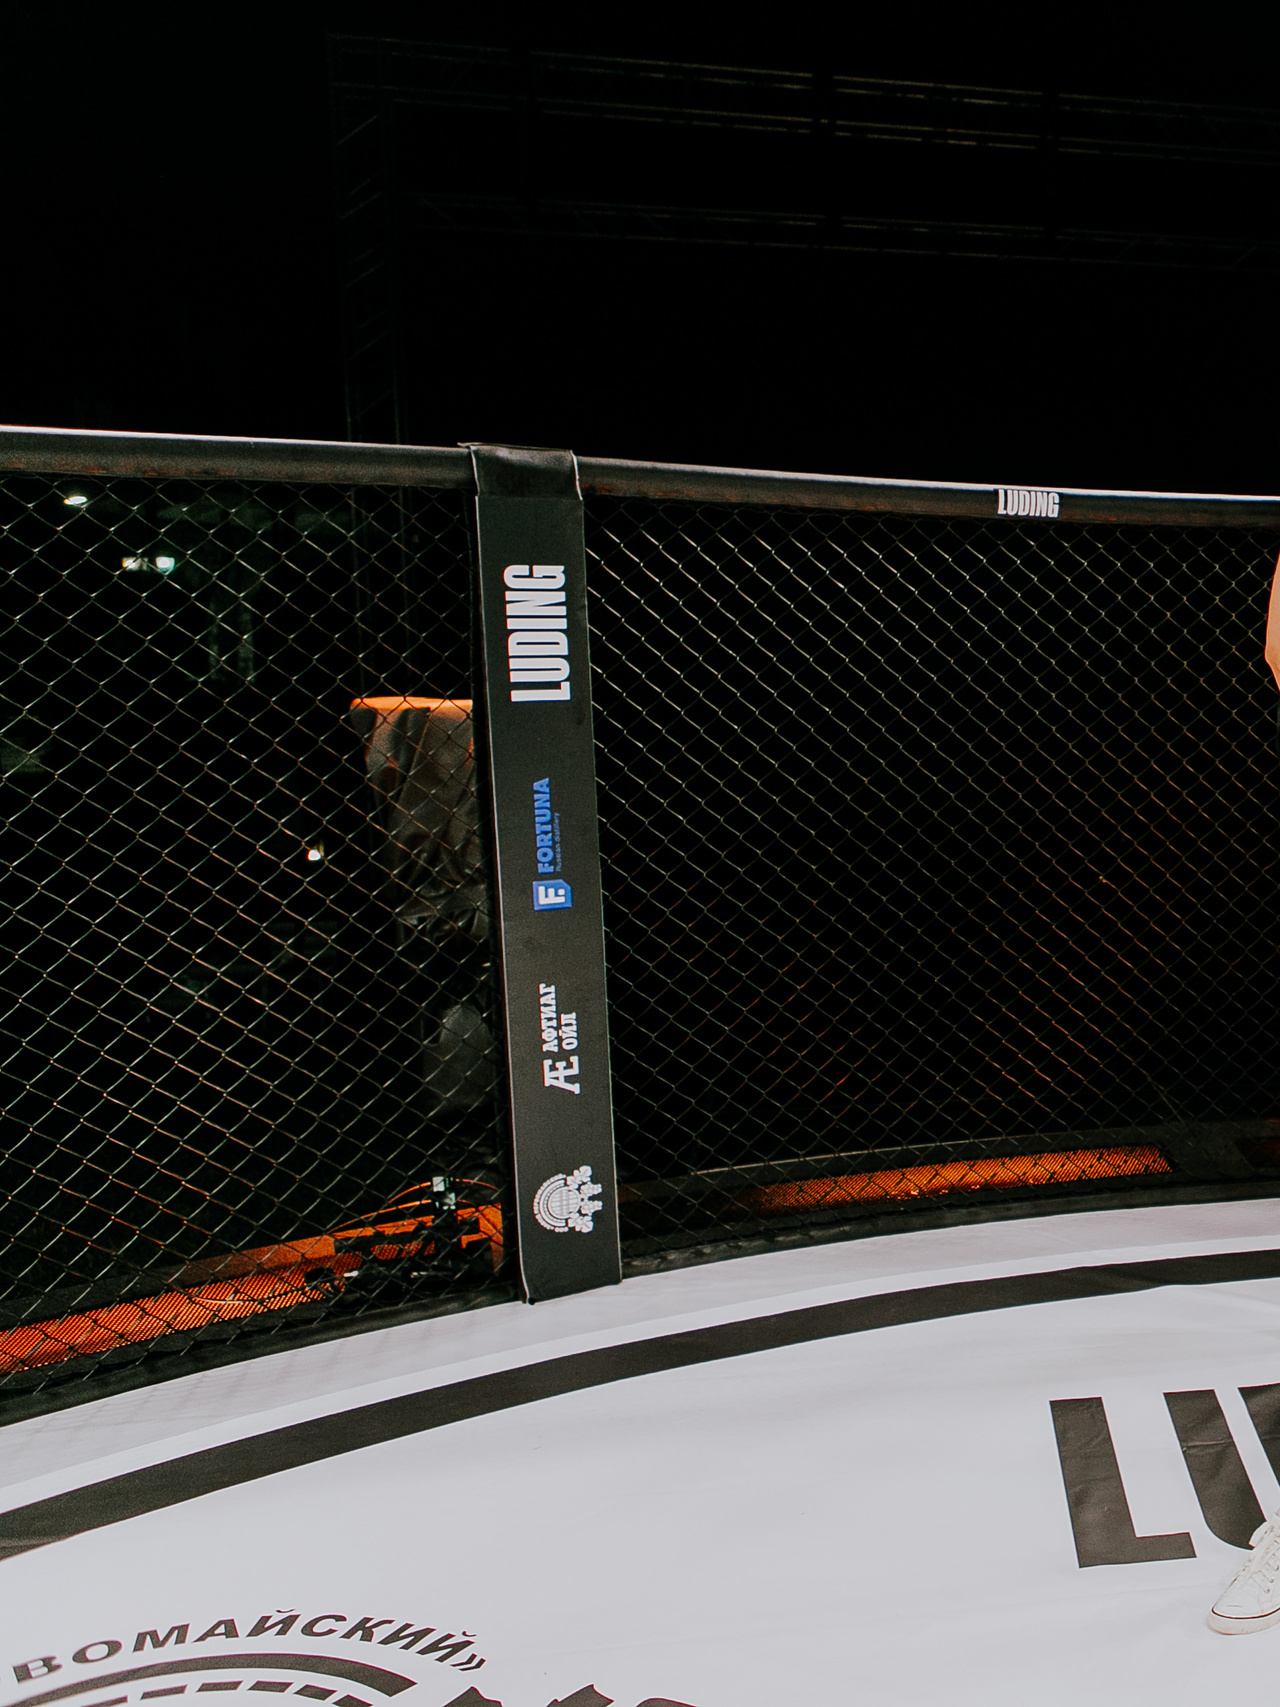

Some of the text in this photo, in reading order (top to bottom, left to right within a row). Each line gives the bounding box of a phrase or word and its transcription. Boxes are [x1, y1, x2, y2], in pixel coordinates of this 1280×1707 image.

[997, 489, 1060, 518] LUDING
[504, 565, 570, 701] LUDING
[533, 777, 554, 874] FORTUNA
[557, 1012, 578, 1051] ОЙЛ
[0, 1608, 486, 1685] ВОМАЙСКИЙ»
